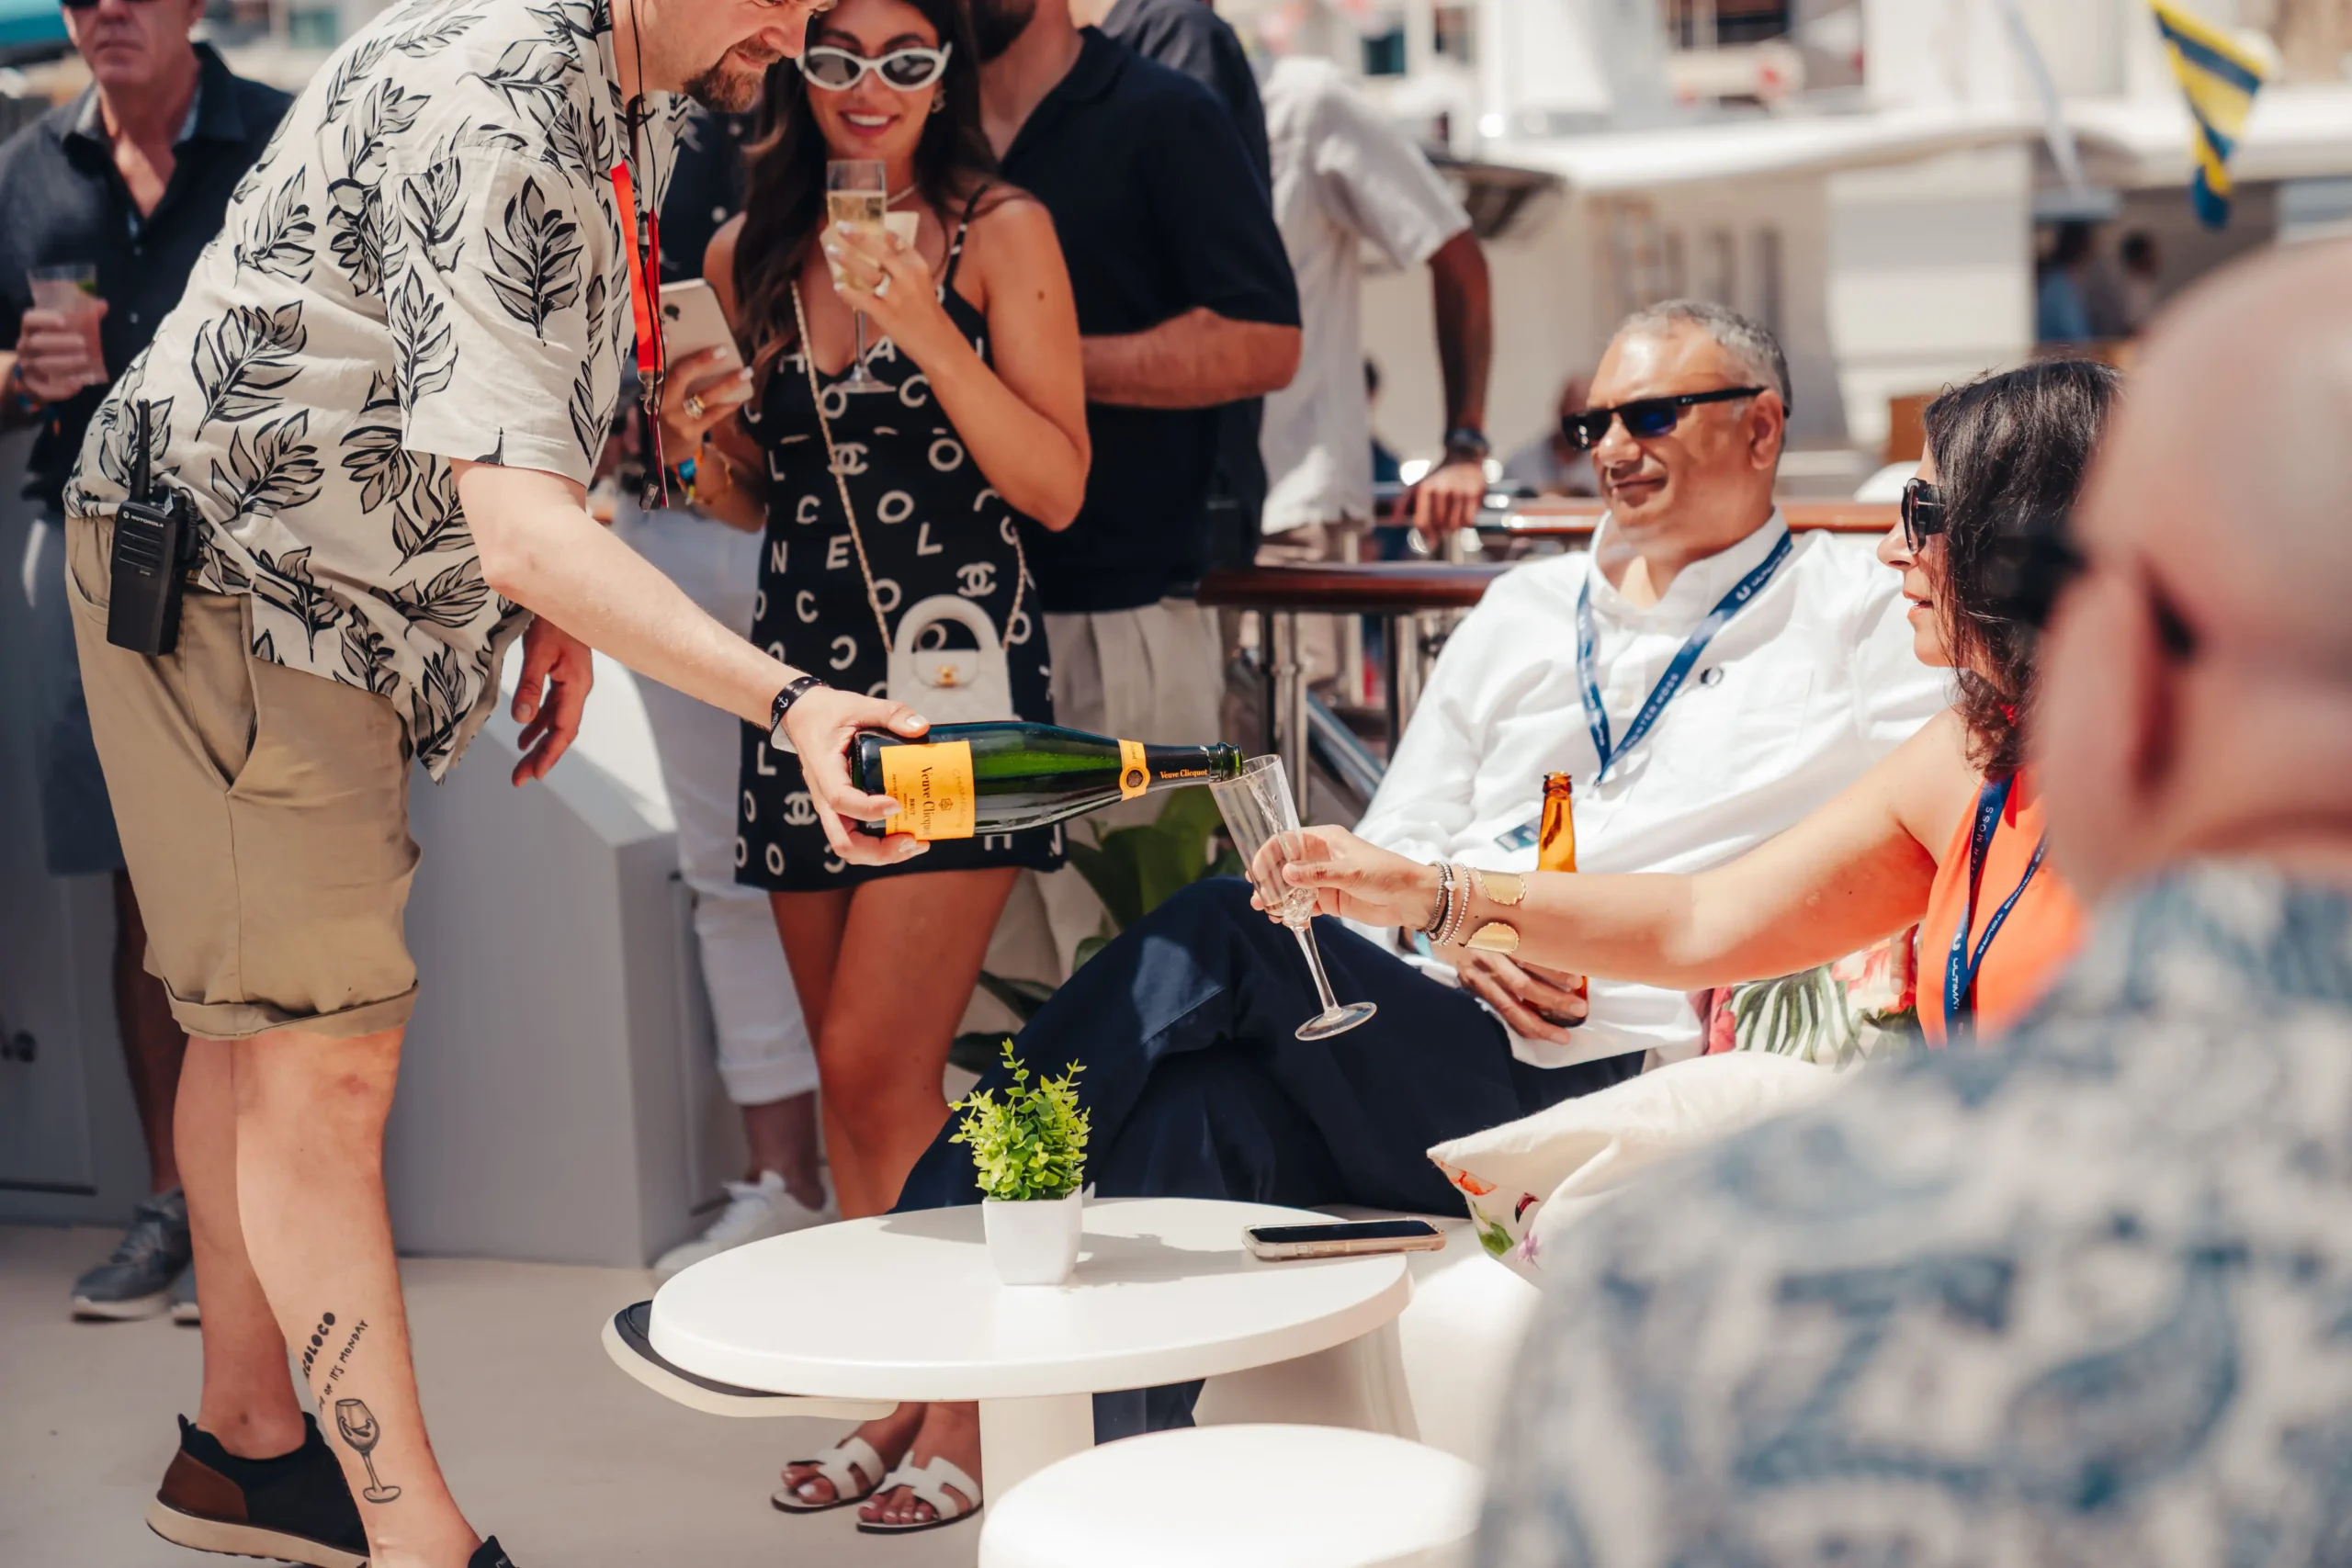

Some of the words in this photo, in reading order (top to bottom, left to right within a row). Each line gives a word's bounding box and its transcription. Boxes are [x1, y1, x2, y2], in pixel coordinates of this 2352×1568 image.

[130, 515, 164, 527] MOTOROLA
[921, 766, 933, 797] Veuve
[1159, 771, 1179, 779] Veuve
[1180, 768, 1208, 778] Clicquot
[920, 800, 935, 835] Clicquot
[1976, 806, 1994, 843] MOSS
[1978, 913, 2003, 953] TOURS
[339, 1319, 368, 1363] MONDAY
